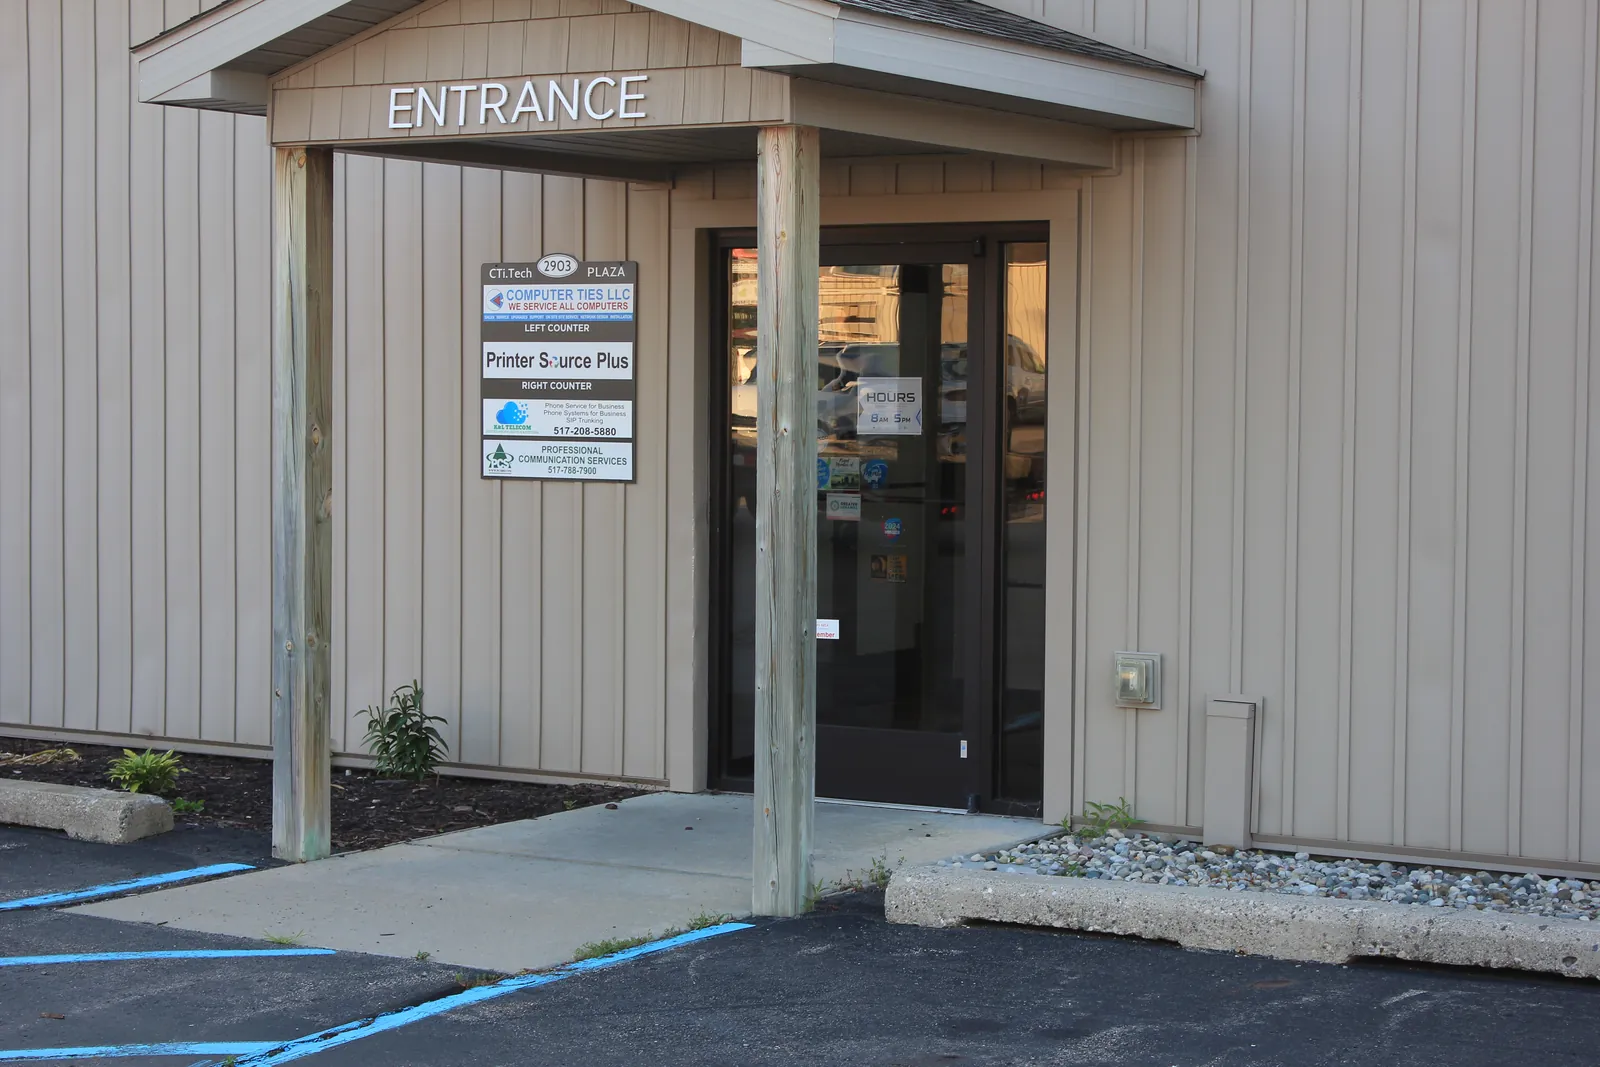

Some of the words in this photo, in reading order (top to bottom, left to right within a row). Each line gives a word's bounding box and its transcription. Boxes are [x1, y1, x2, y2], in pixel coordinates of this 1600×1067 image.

[388, 75, 648, 129] ENTRANCE
[544, 260, 572, 272] 2903
[489, 268, 532, 279] CTi.Tech
[587, 267, 626, 277] PLAZA
[506, 289, 574, 301] COMPUTER
[577, 288, 603, 301] TIES
[607, 288, 630, 300] LLC
[508, 302, 521, 310] WE
[523, 302, 558, 311] SERVICE
[560, 302, 575, 310] ALL
[577, 301, 628, 310] COMPUTERS
[524, 323, 545, 332] LEFT
[547, 323, 590, 332] COUNTER
[486, 351, 535, 368] Printer
[597, 352, 629, 369] Plus
[521, 381, 548, 390] RIGHT
[550, 381, 592, 390] COUNTER
[866, 392, 916, 403] HOURS
[563, 410, 589, 418] Systems
[579, 417, 604, 425] Trunking
[553, 426, 617, 436] 517-208-5880
[541, 445, 603, 455] PROFESSIONAL
[518, 455, 585, 465] COMMUNICATION
[587, 456, 627, 466] SERVICES
[547, 466, 597, 475] 517-788-7900
[884, 522, 901, 530] 2024
